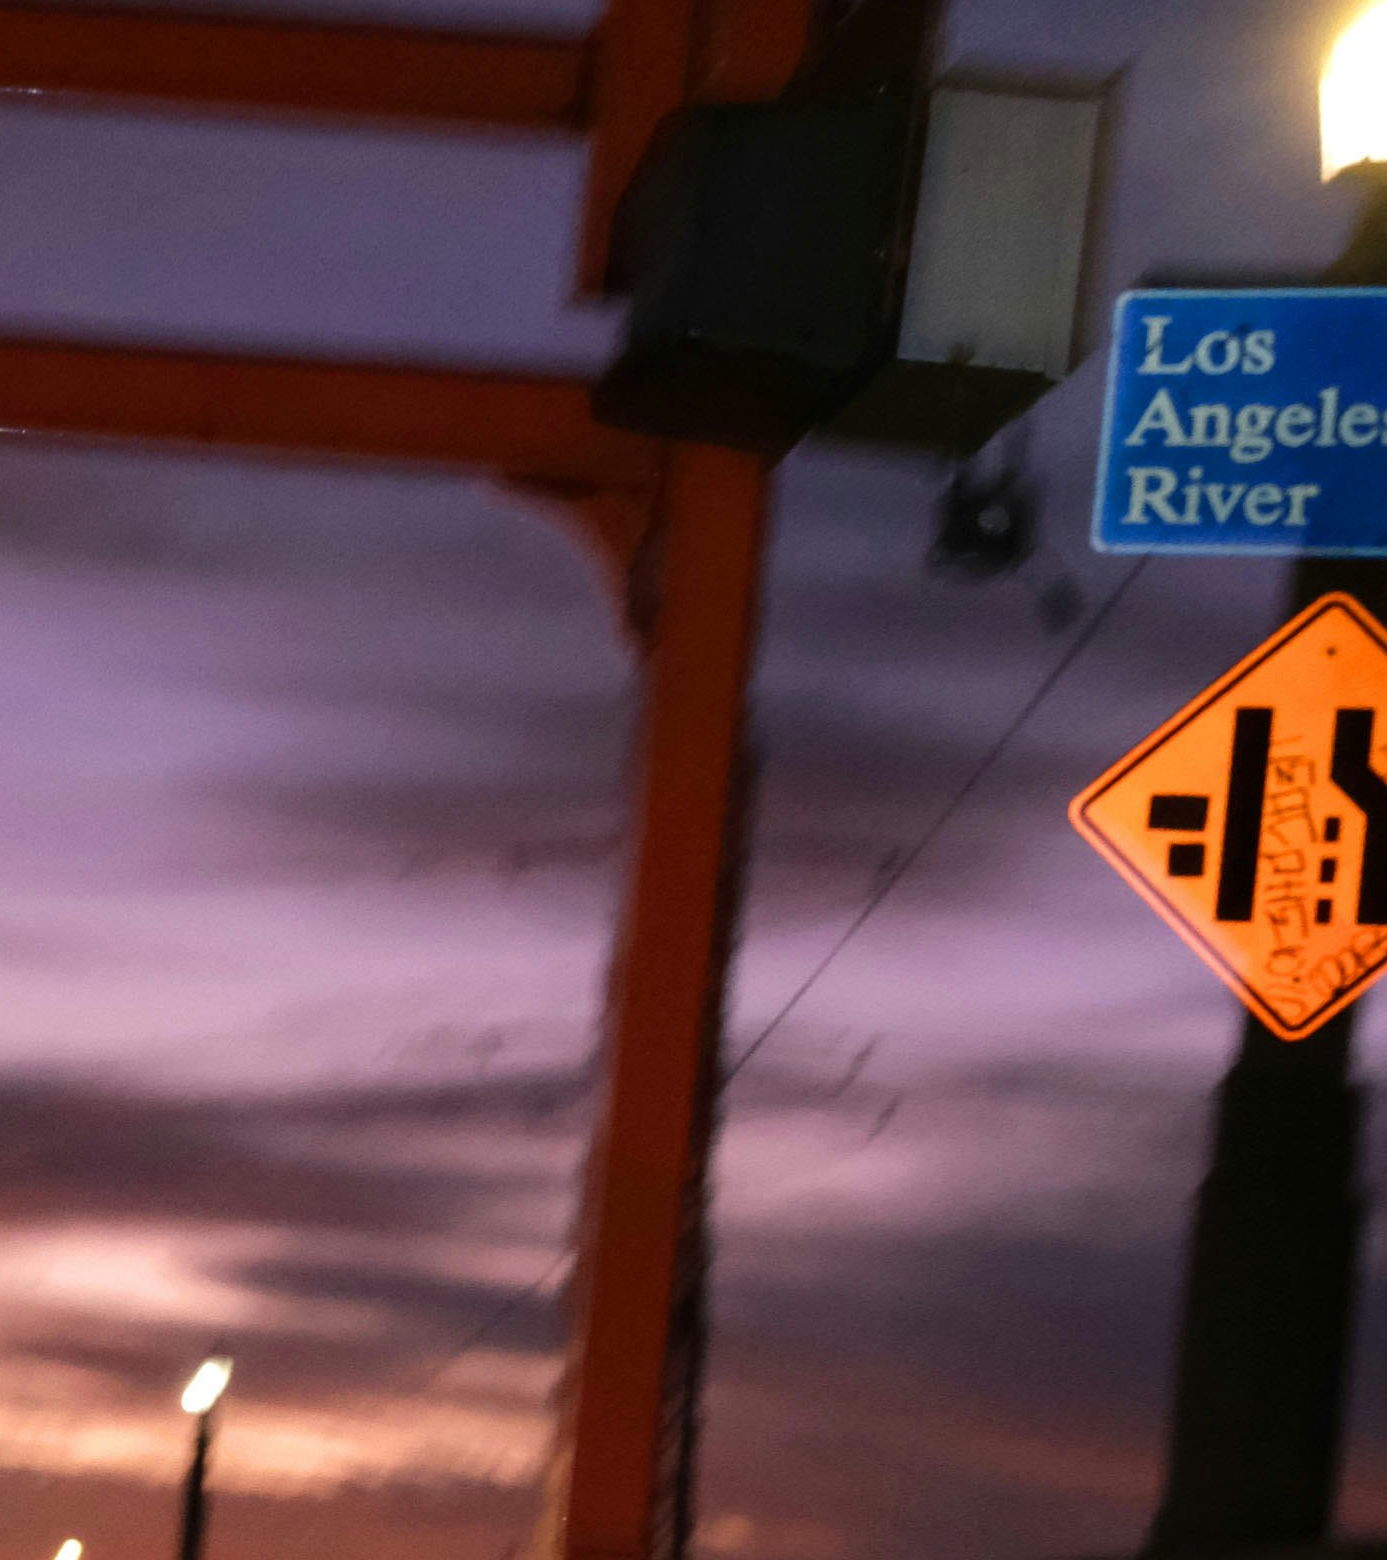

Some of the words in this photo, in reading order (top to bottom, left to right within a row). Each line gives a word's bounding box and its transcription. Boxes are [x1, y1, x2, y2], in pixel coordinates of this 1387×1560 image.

[1135, 313, 1277, 377] Los
[1123, 385, 1387, 465] Angele
[1118, 463, 1323, 527] River
